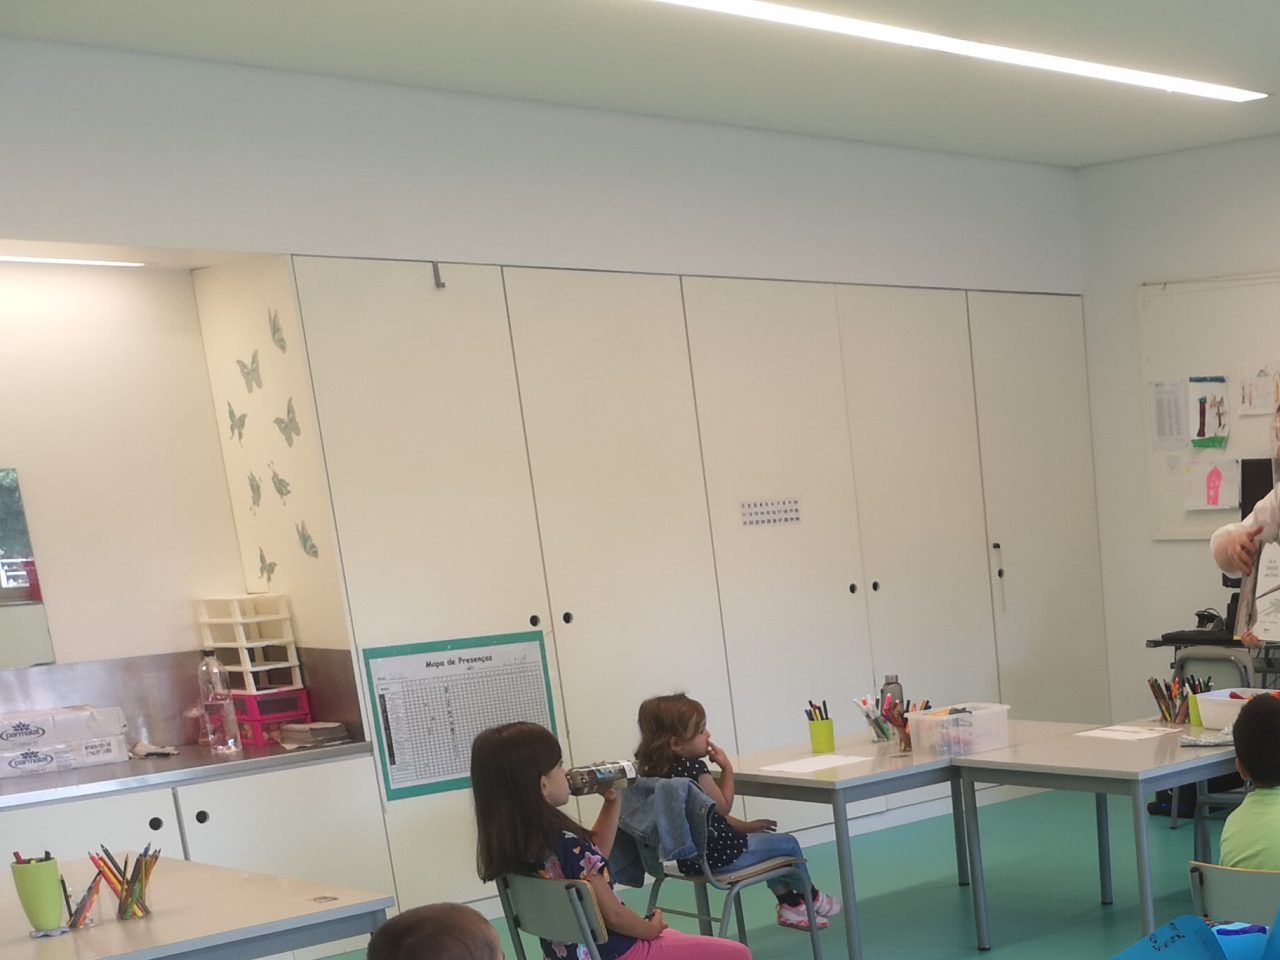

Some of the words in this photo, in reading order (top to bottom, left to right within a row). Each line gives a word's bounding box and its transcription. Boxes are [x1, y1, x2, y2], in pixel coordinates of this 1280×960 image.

[425, 660, 445, 669] Mapa
[447, 657, 456, 666] de
[458, 655, 493, 664] Presenças
[5, 727, 40, 741] parmalat
[14, 754, 49, 767] parmalat
